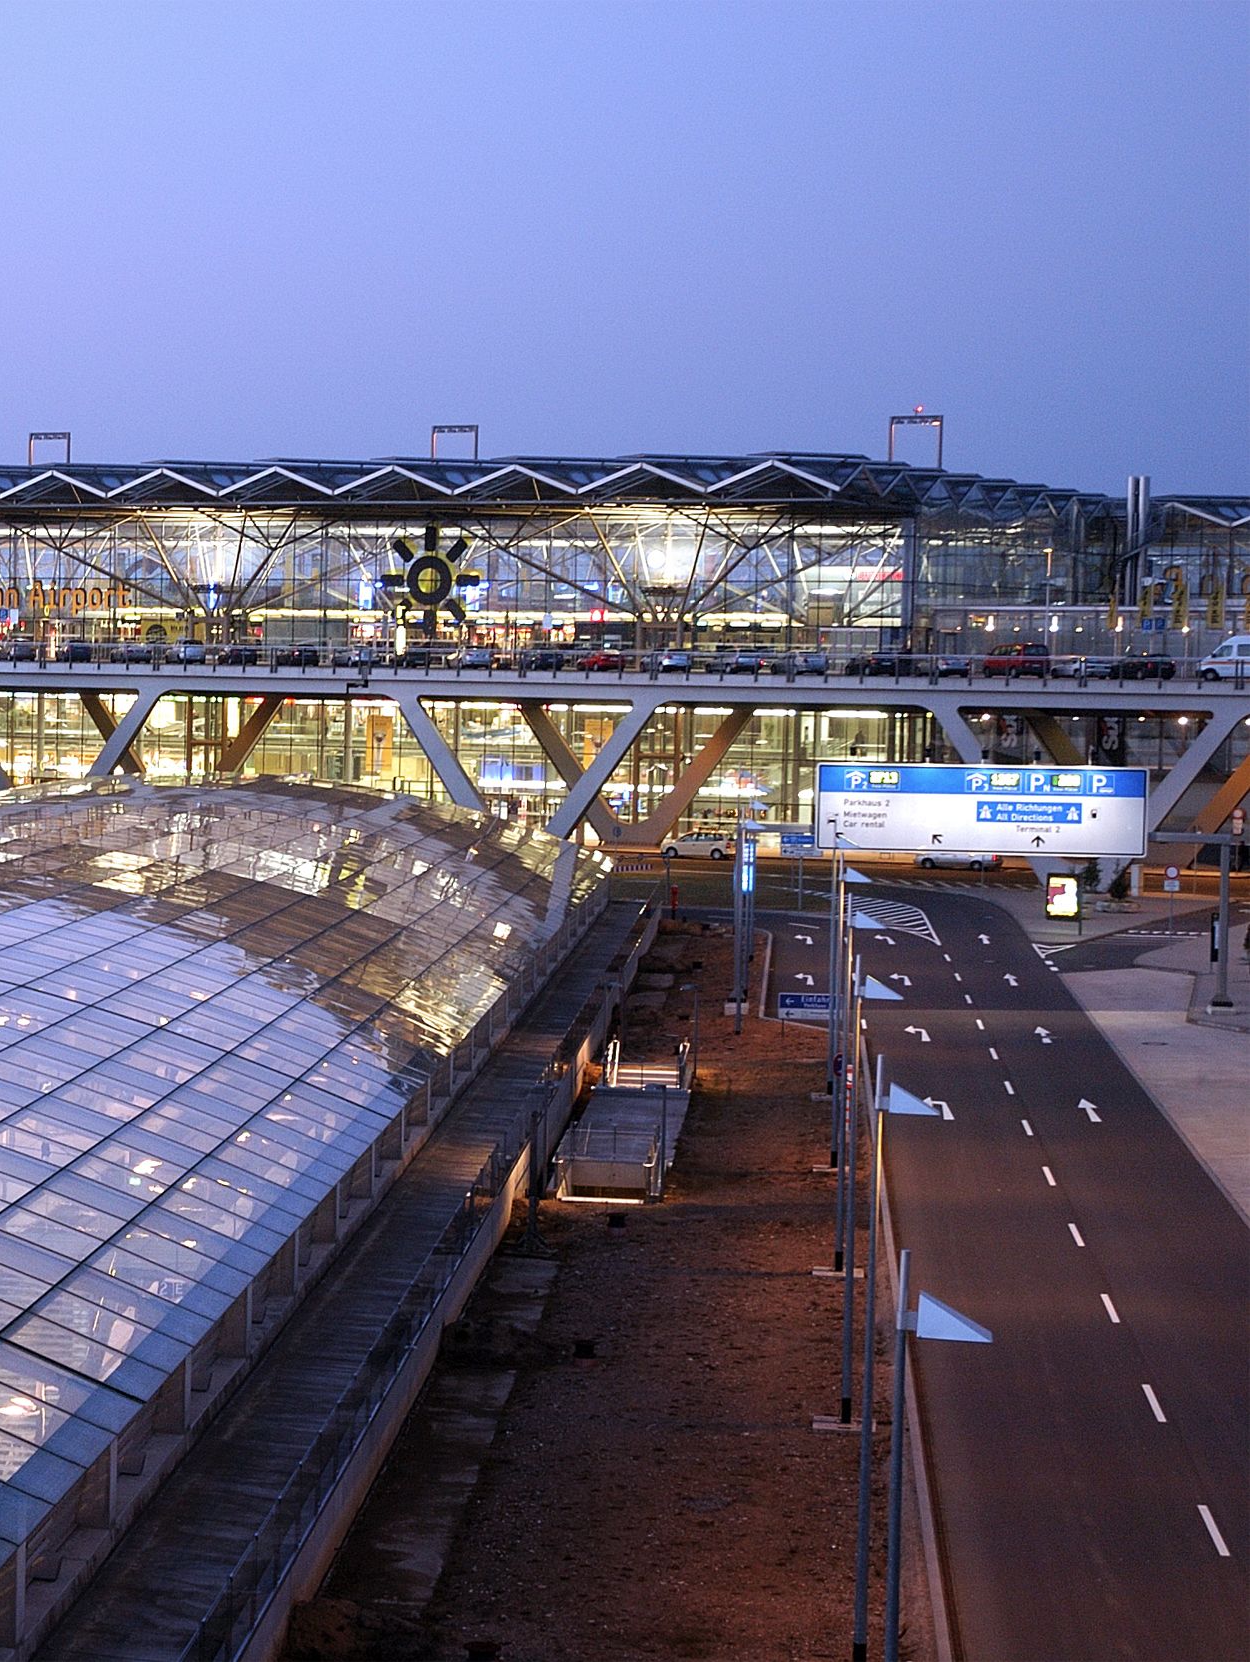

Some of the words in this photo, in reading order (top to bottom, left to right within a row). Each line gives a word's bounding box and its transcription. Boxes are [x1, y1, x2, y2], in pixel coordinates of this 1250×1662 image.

[29, 579, 132, 617] Airport
[844, 799, 882, 807] Parkhaus
[996, 803, 1013, 812] Alle
[1015, 803, 1063, 814] Richtungen
[843, 810, 888, 820] Mietwagen
[996, 813, 1009, 821] All
[1011, 813, 1054, 822] Directions
[843, 820, 858, 828] Car
[861, 820, 885, 828] rental
[1016, 825, 1052, 833] Terminal
[801, 995, 830, 1003] Einfahr
